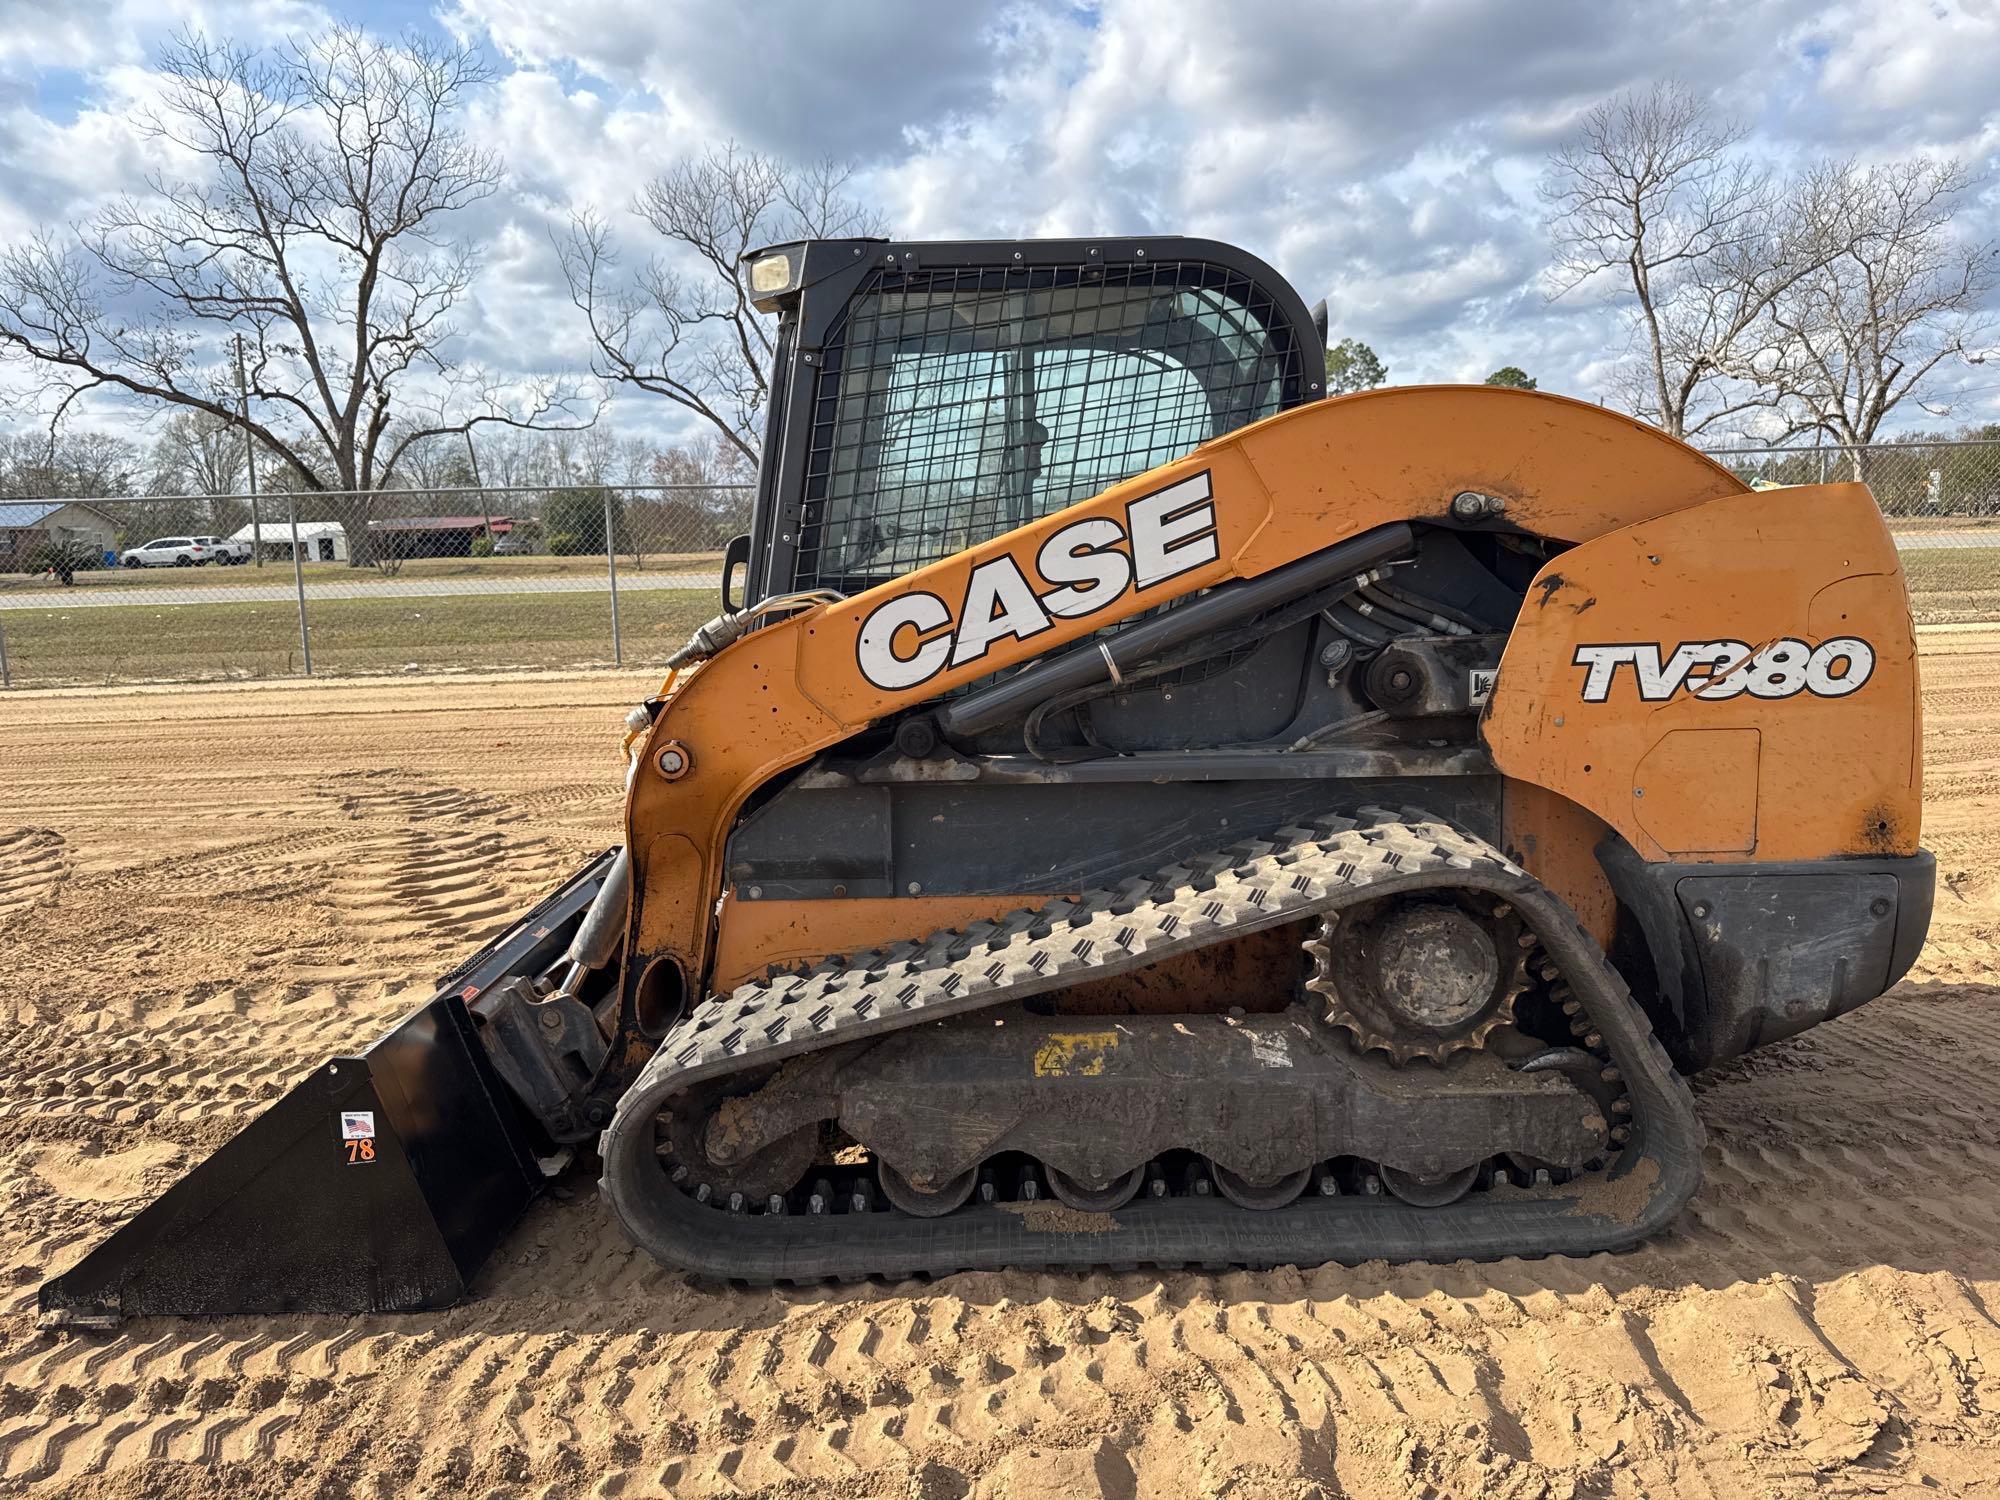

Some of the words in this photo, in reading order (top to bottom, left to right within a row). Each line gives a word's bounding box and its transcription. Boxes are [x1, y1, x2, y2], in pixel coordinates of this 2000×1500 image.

[855, 468, 1221, 691] CASE
[1571, 635, 1876, 703] TV380
[344, 1138, 375, 1162] 78
